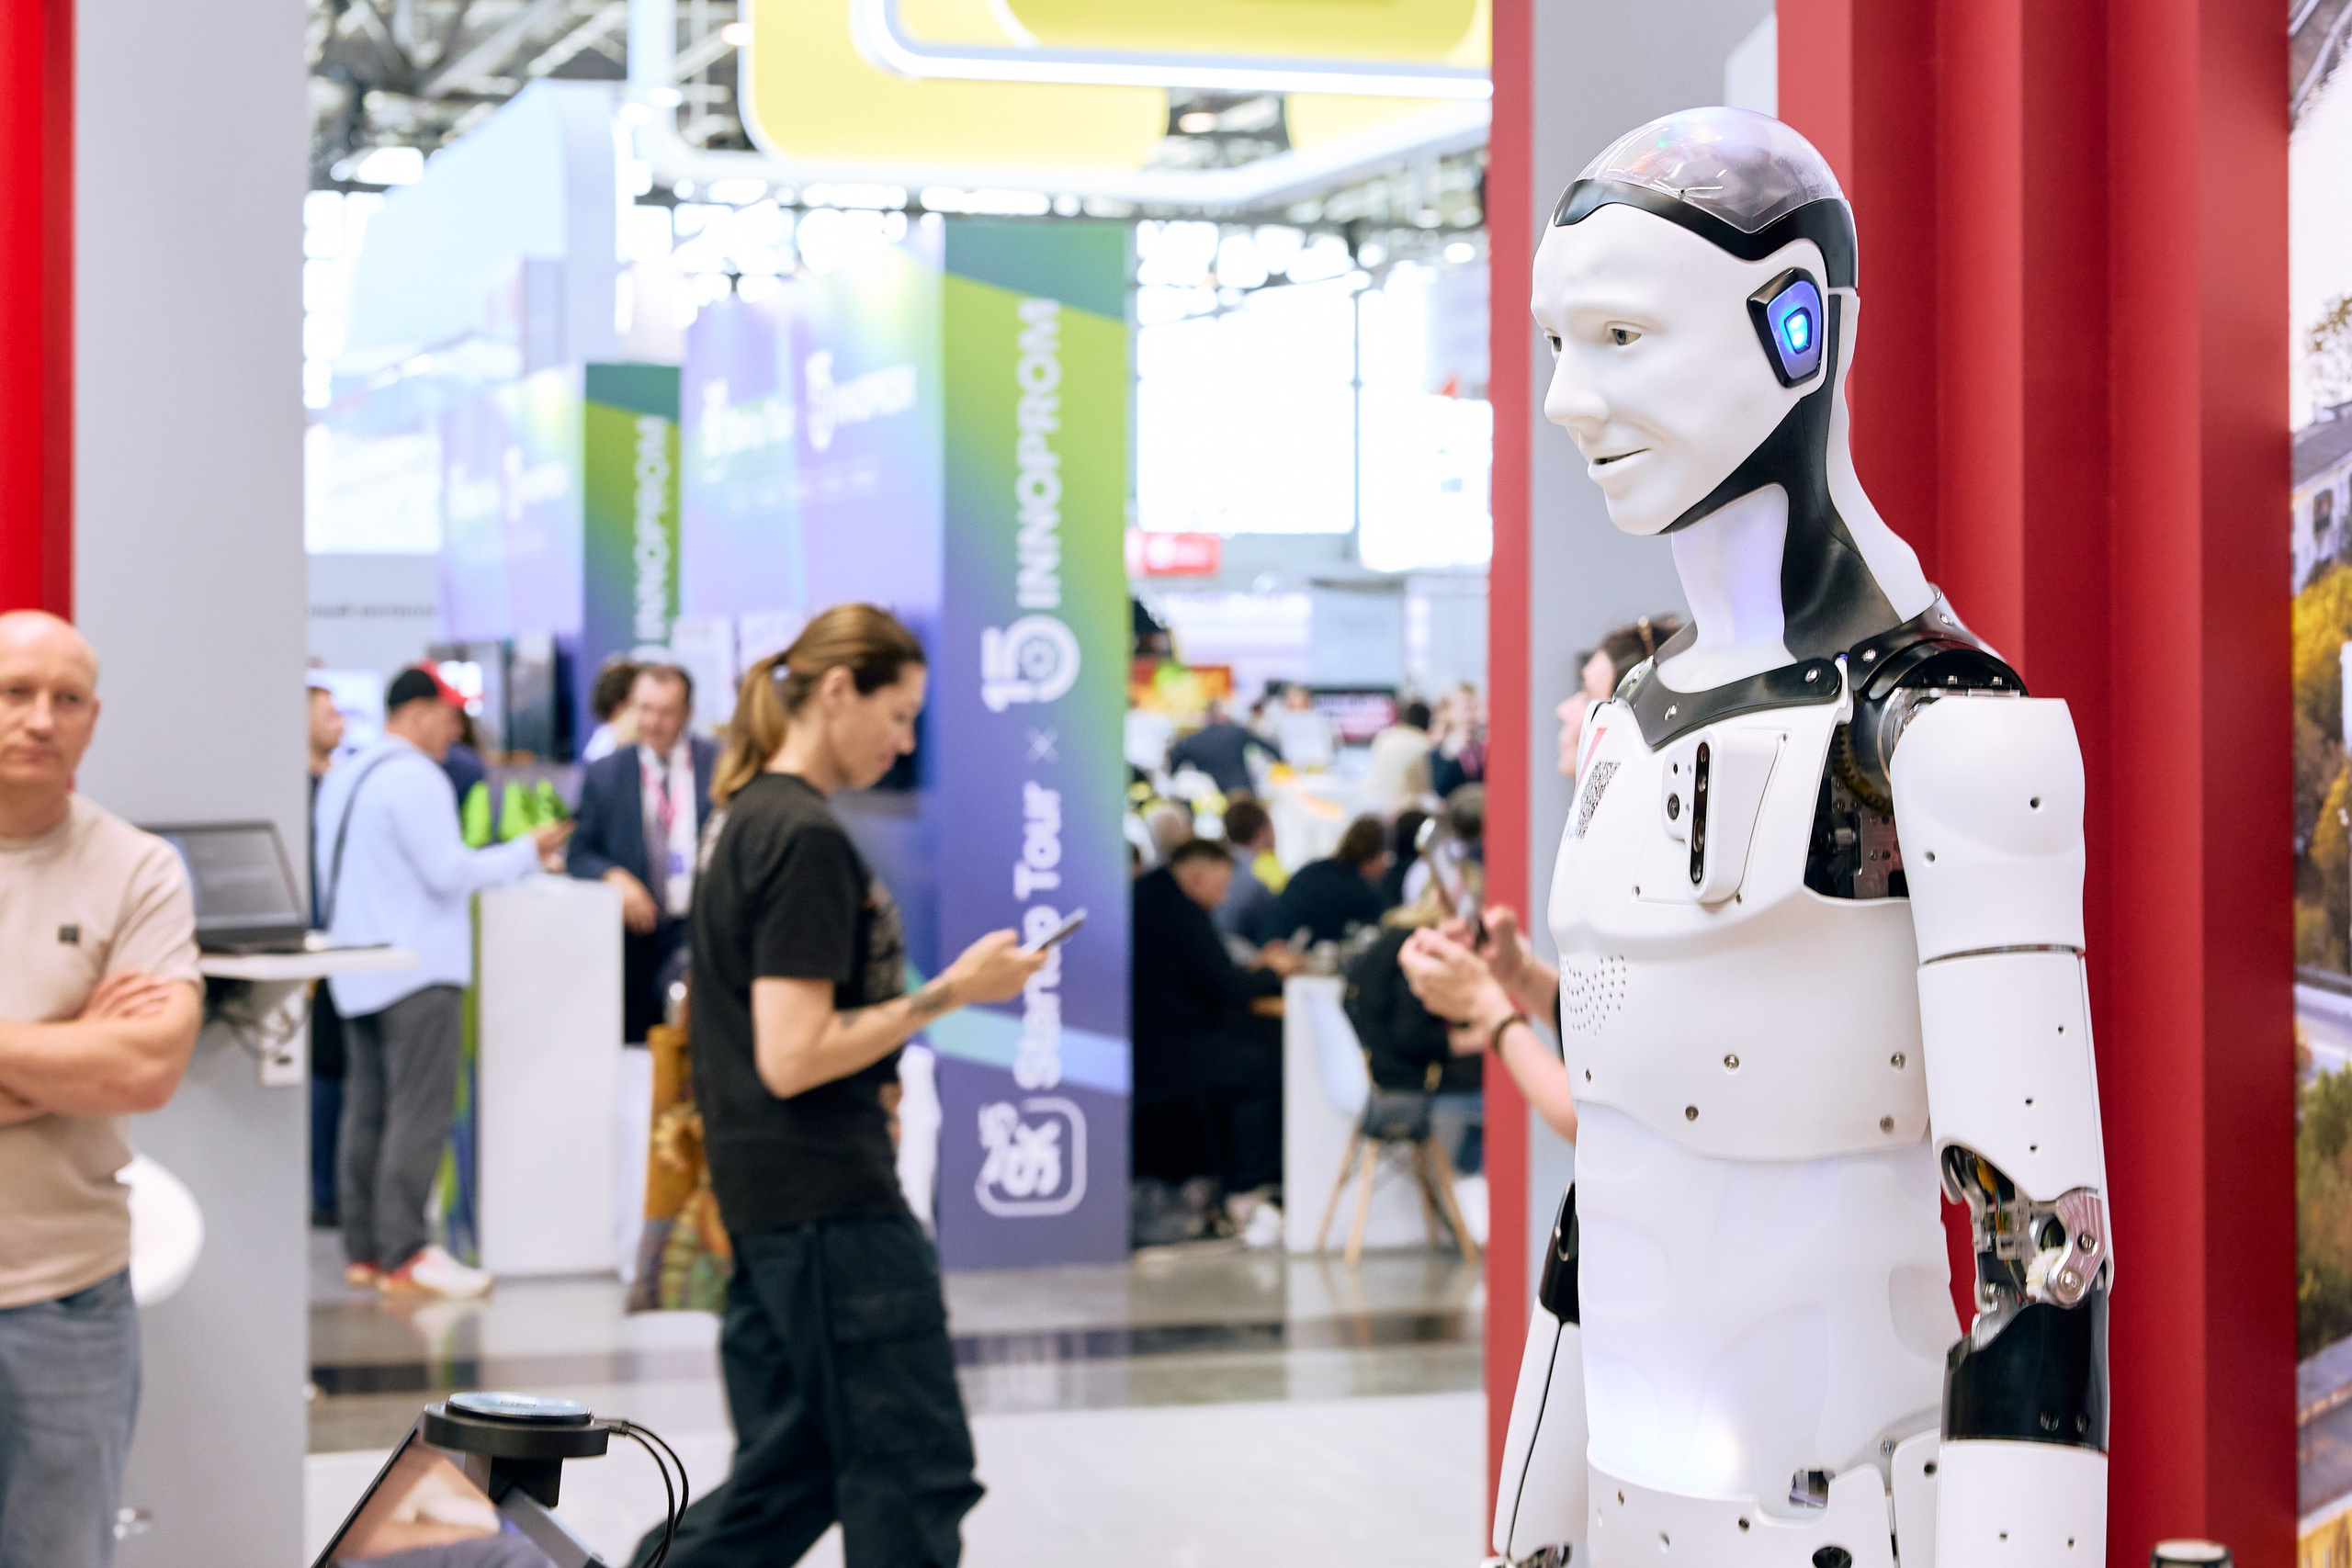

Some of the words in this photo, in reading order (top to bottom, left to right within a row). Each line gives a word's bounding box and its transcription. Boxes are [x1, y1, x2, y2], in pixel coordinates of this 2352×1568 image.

[634, 415, 670, 640] INNOPROM
[1015, 299, 1062, 608] INNOPROM
[1014, 781, 1062, 899] Tour
